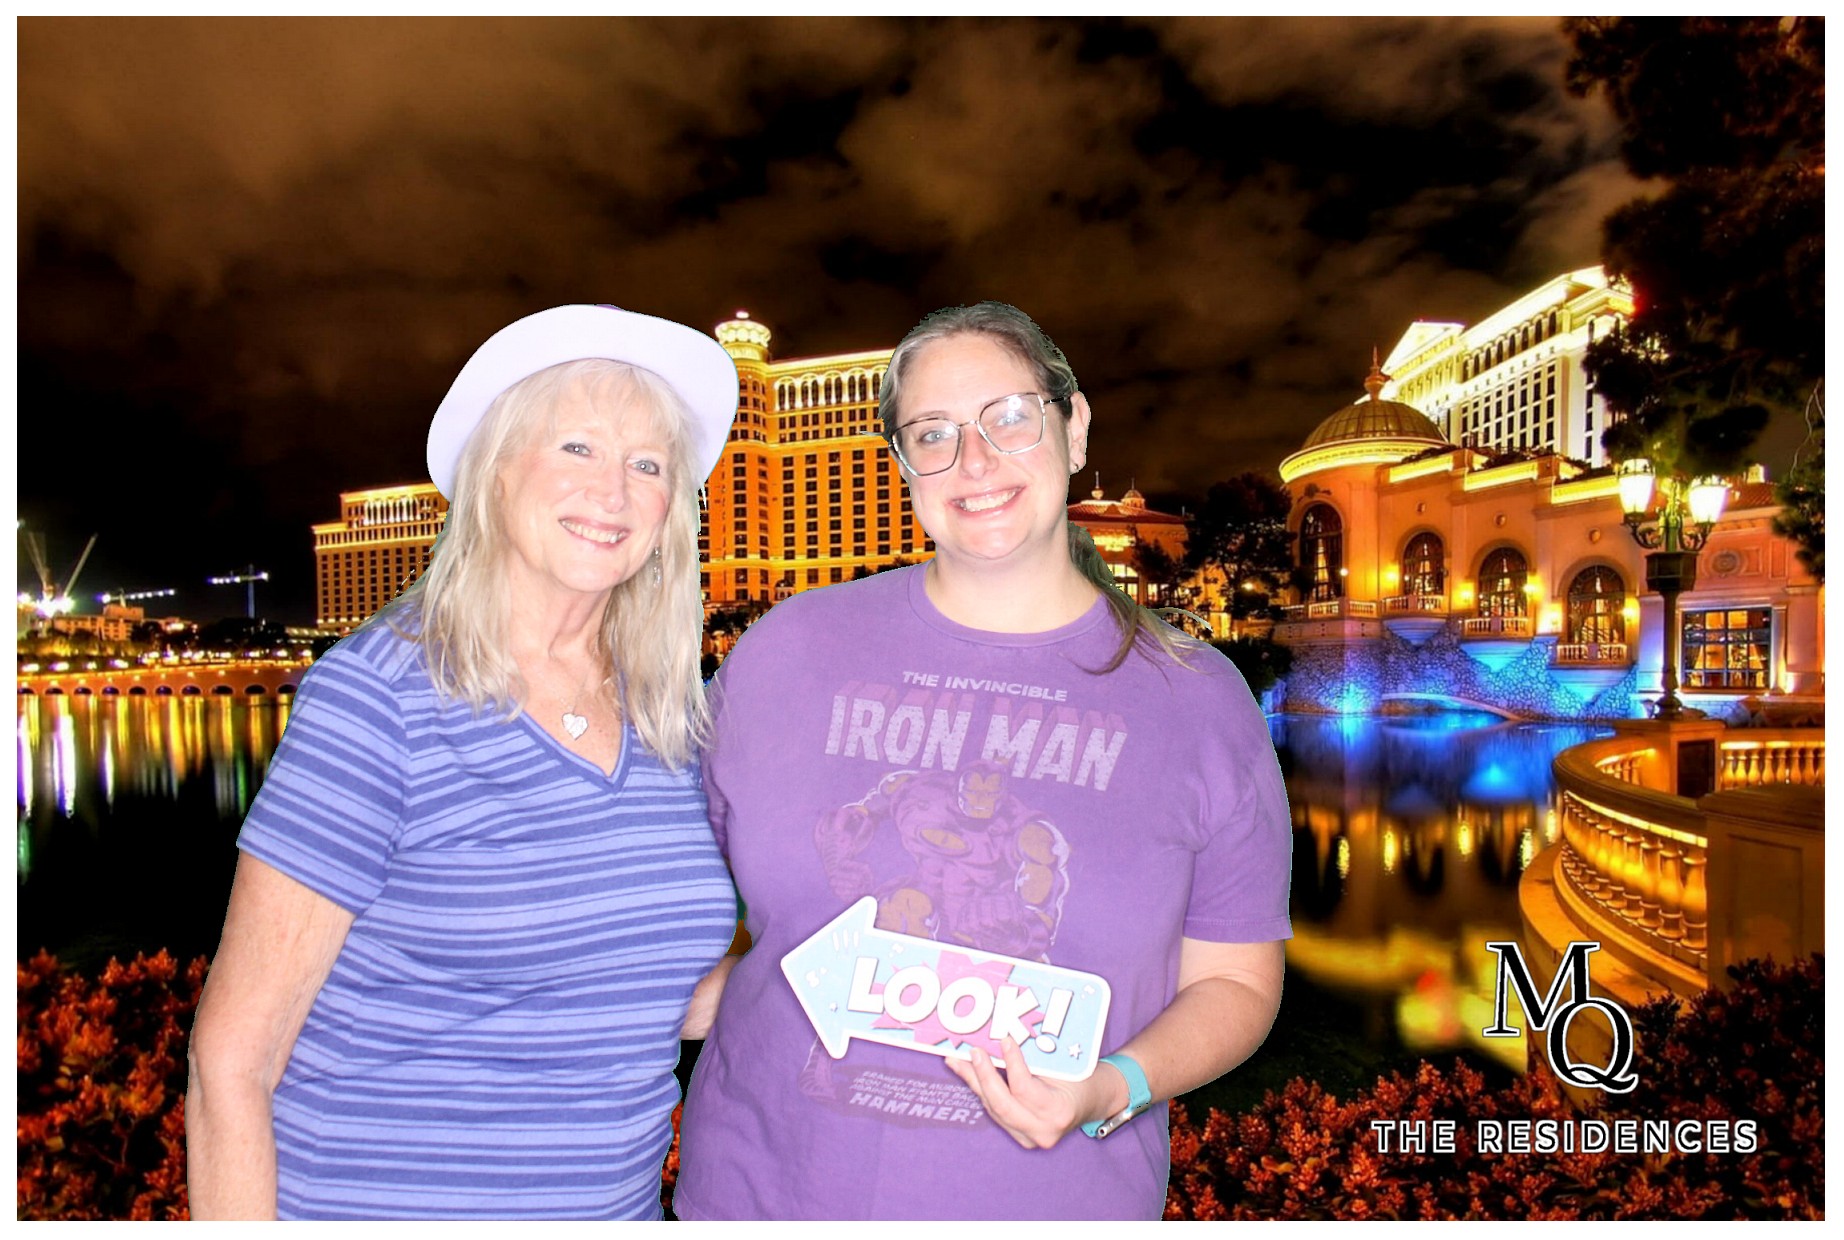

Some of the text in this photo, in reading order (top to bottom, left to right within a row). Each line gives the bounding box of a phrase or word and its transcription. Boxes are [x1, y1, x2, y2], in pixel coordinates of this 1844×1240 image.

[902, 671, 1068, 702] THE INVINCIBLE
[824, 694, 1128, 791] IRON MAN
[847, 956, 1074, 1054] LOOK!
[849, 1092, 983, 1125] HAMMER!
